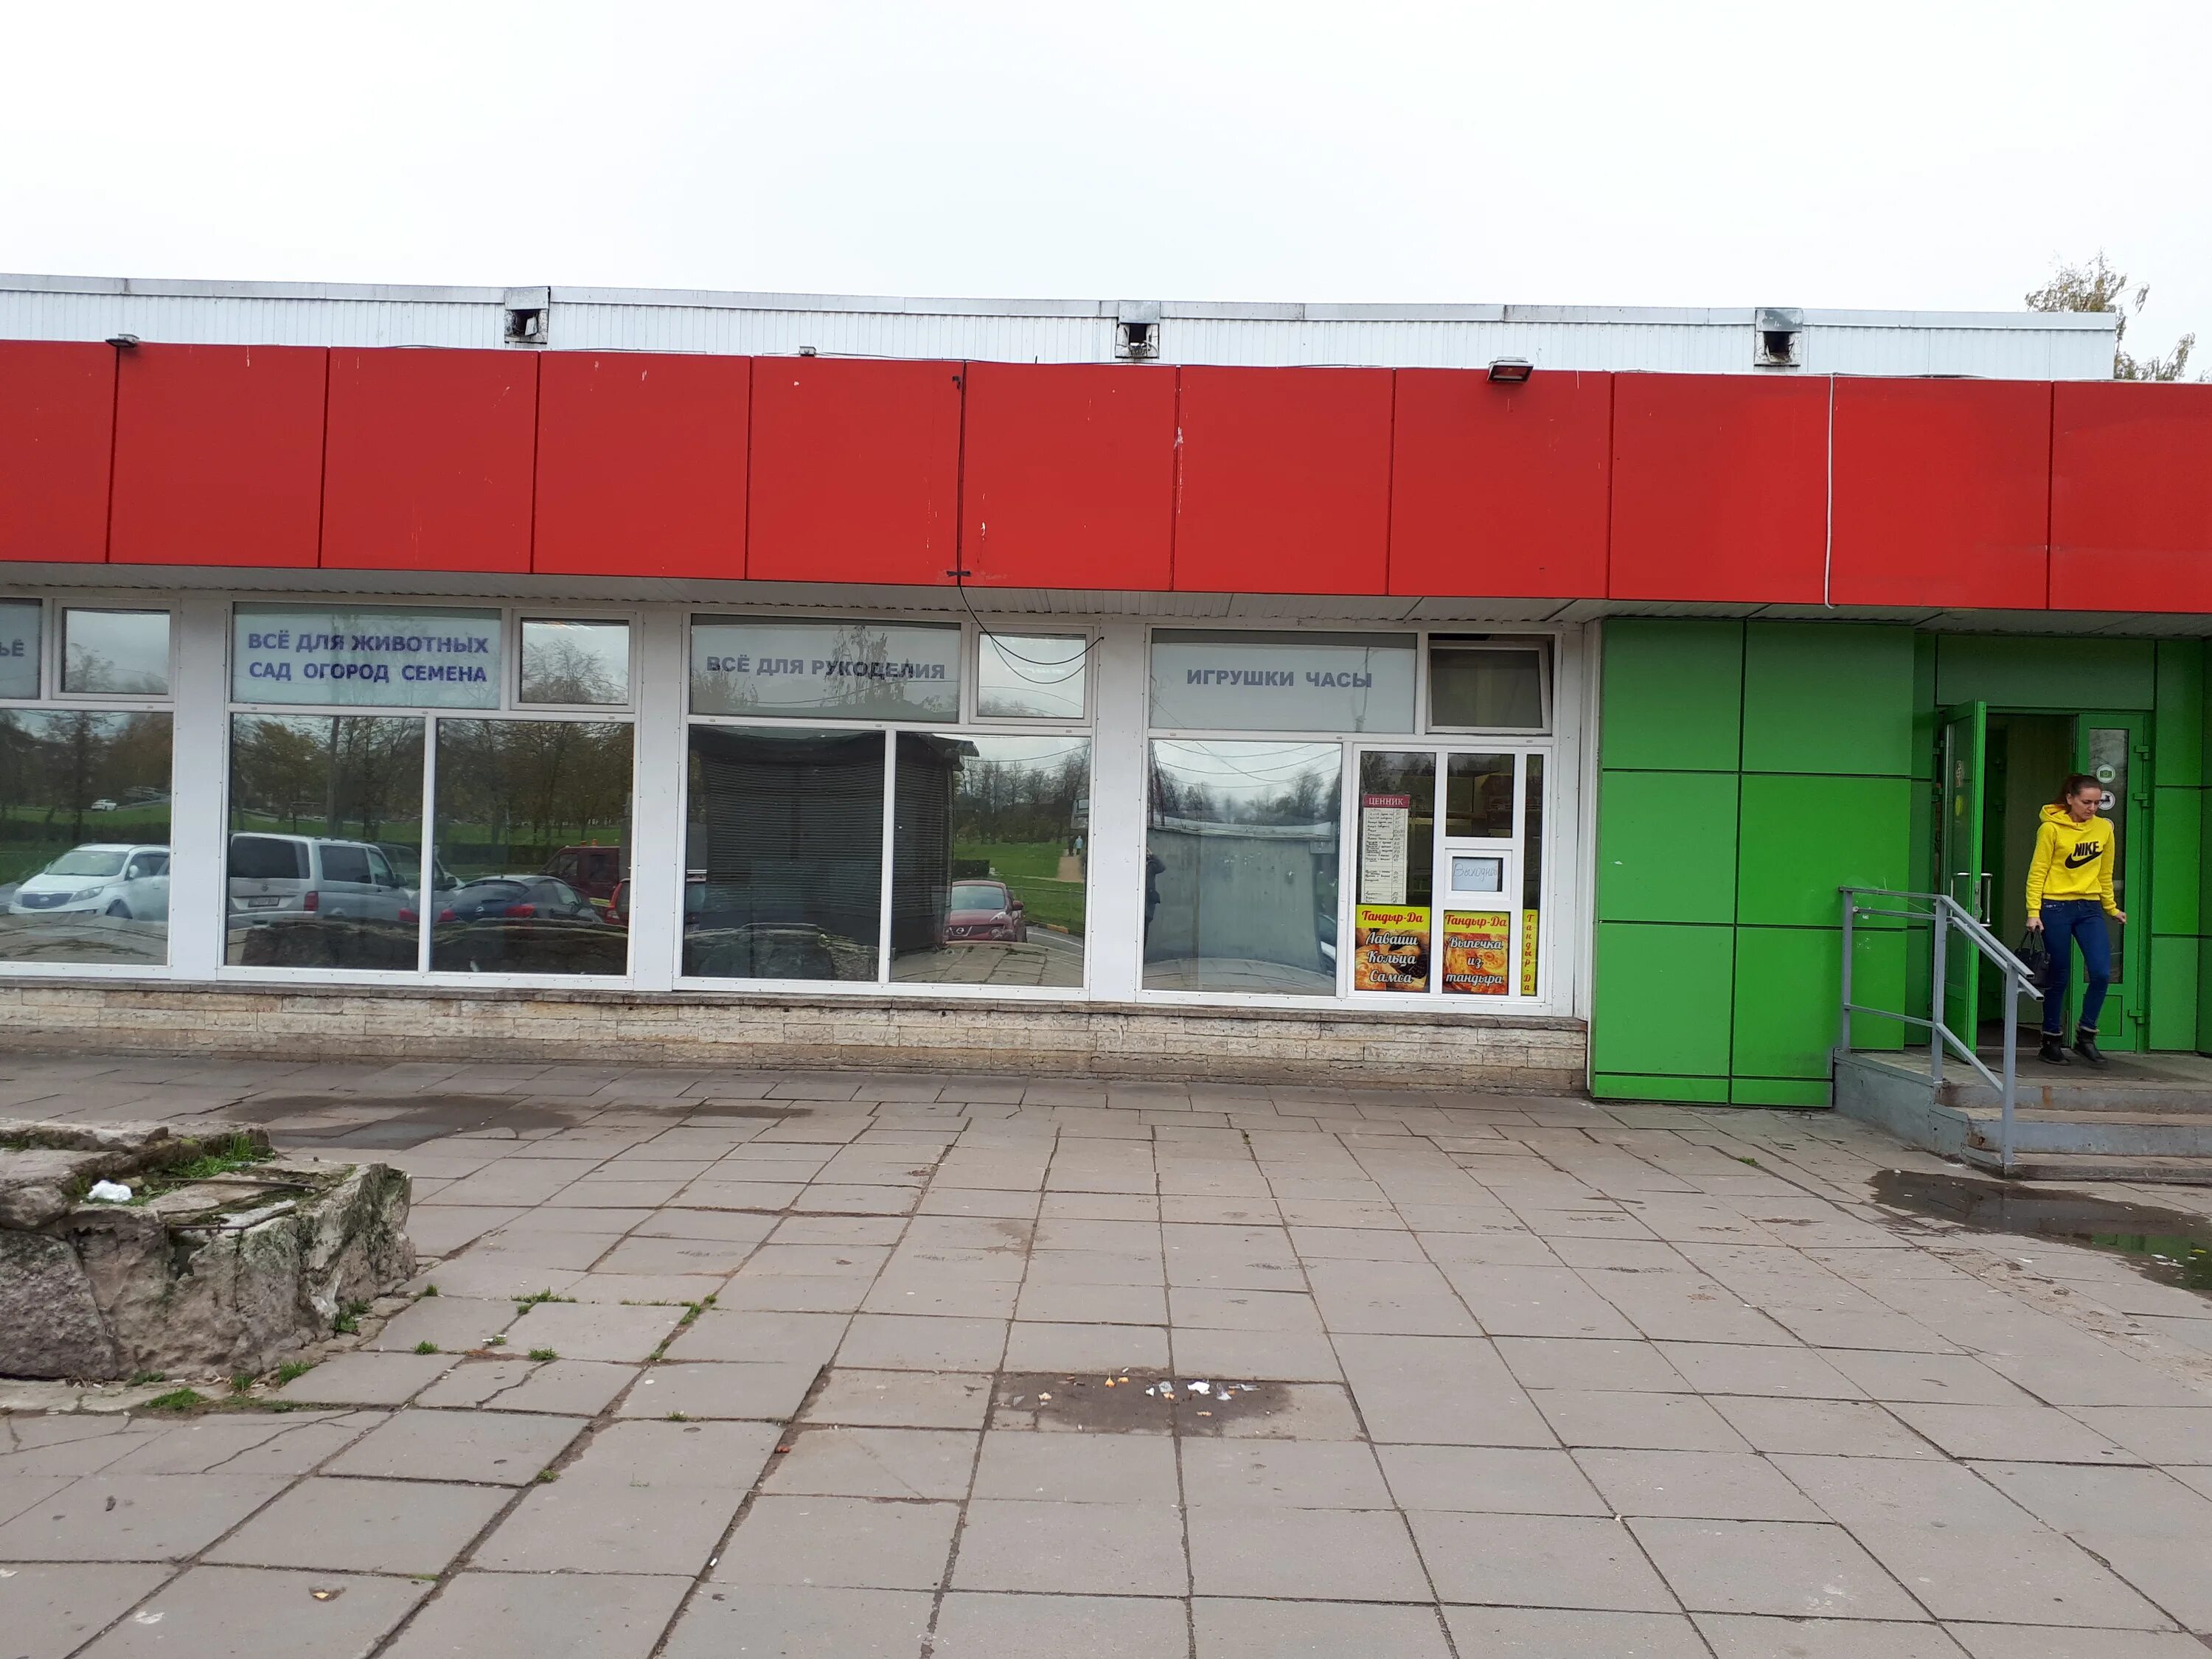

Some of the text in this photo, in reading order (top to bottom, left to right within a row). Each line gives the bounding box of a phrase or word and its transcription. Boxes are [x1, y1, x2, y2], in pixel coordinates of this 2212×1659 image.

[248, 630, 490, 654] ВСЁ ДЛЯ ЖИВОТНЫХ
[248, 661, 487, 683] САД ОГОРОД СЕМЕНА
[706, 654, 945, 680] ВСЁ ДЛЯ РУКОДЕЛИЯ
[1186, 669, 1372, 689] ИГРУШКИ ЧАСЫ
[1368, 797, 1404, 805] ЦЕННИК
[2073, 841, 2099, 857] NIKE
[1361, 910, 1424, 925] Тандыр-Да
[1444, 914, 1507, 929] Тандыр-Да
[1366, 931, 1419, 945] Лаваши
[1449, 936, 1503, 950] Выпечка
[1367, 950, 1416, 967] Кольца
[1467, 957, 1484, 969] из
[1369, 969, 1413, 983] Самса
[1445, 974, 1503, 987] тандыра
